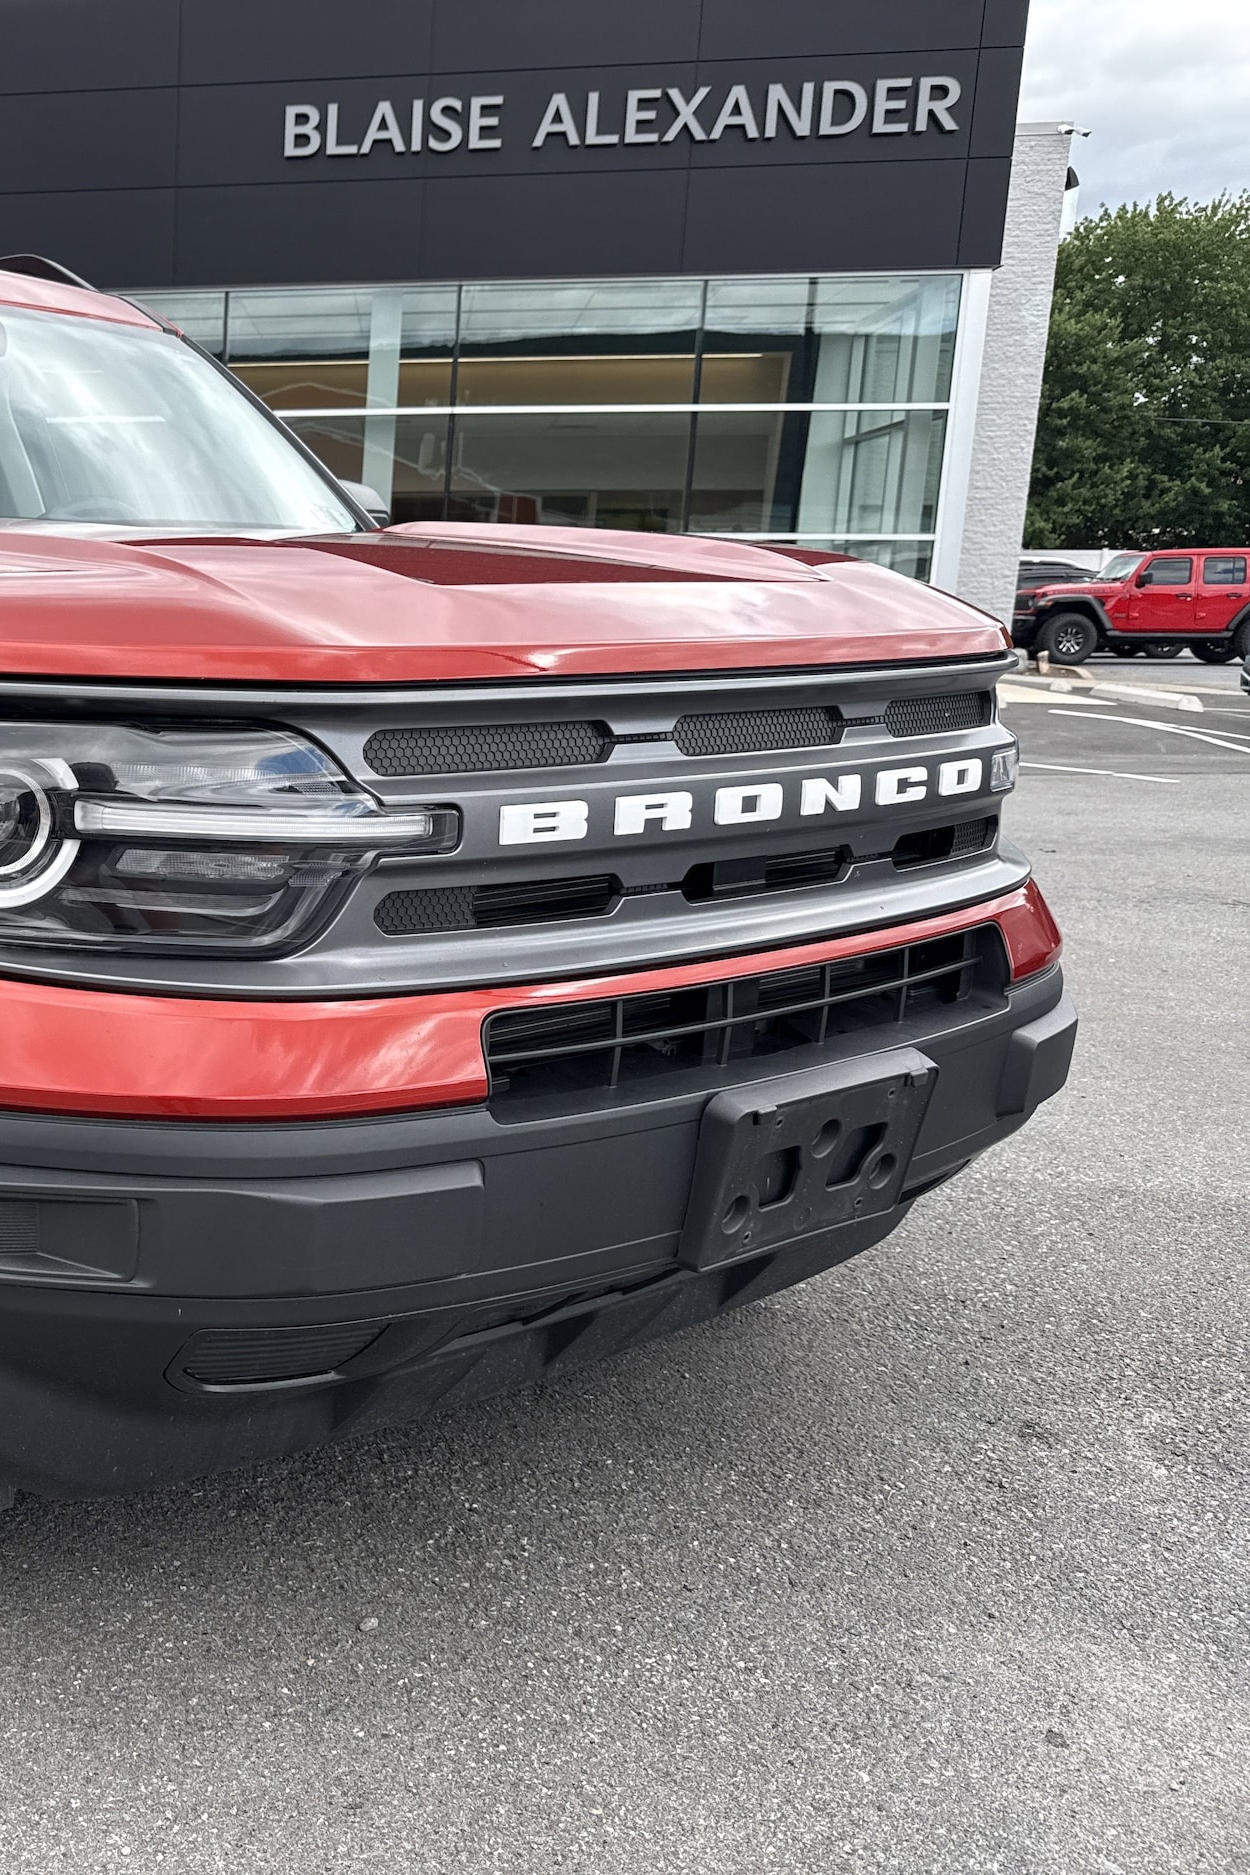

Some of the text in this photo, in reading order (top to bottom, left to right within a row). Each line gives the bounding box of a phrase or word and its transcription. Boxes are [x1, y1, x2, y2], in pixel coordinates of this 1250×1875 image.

[283, 75, 962, 158] BLAISE ALEXANDER
[498, 758, 983, 846] BRONCO
